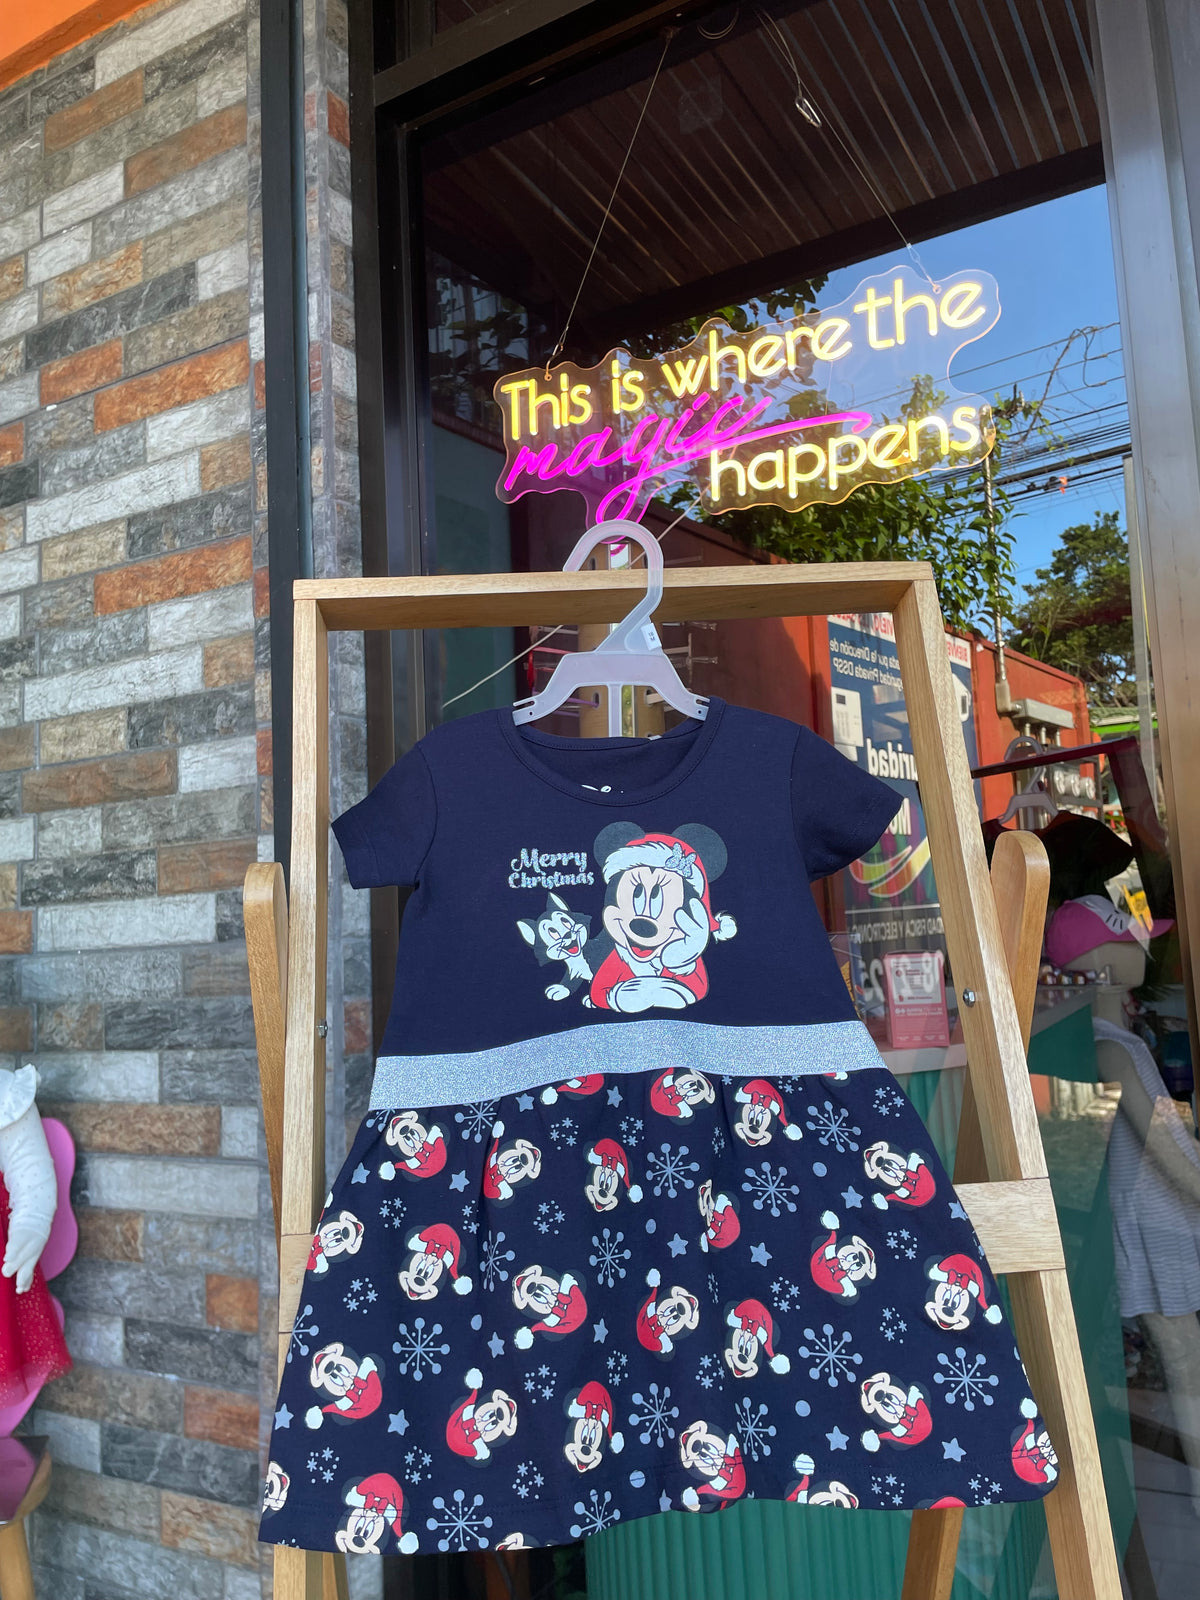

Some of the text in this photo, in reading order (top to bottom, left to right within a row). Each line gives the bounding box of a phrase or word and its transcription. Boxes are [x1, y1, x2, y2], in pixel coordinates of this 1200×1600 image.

[500, 278, 987, 441] This is where the
[503, 391, 872, 524] magic
[708, 406, 980, 502] happens
[508, 870, 595, 889] Christmas
[510, 848, 588, 872] Merry
